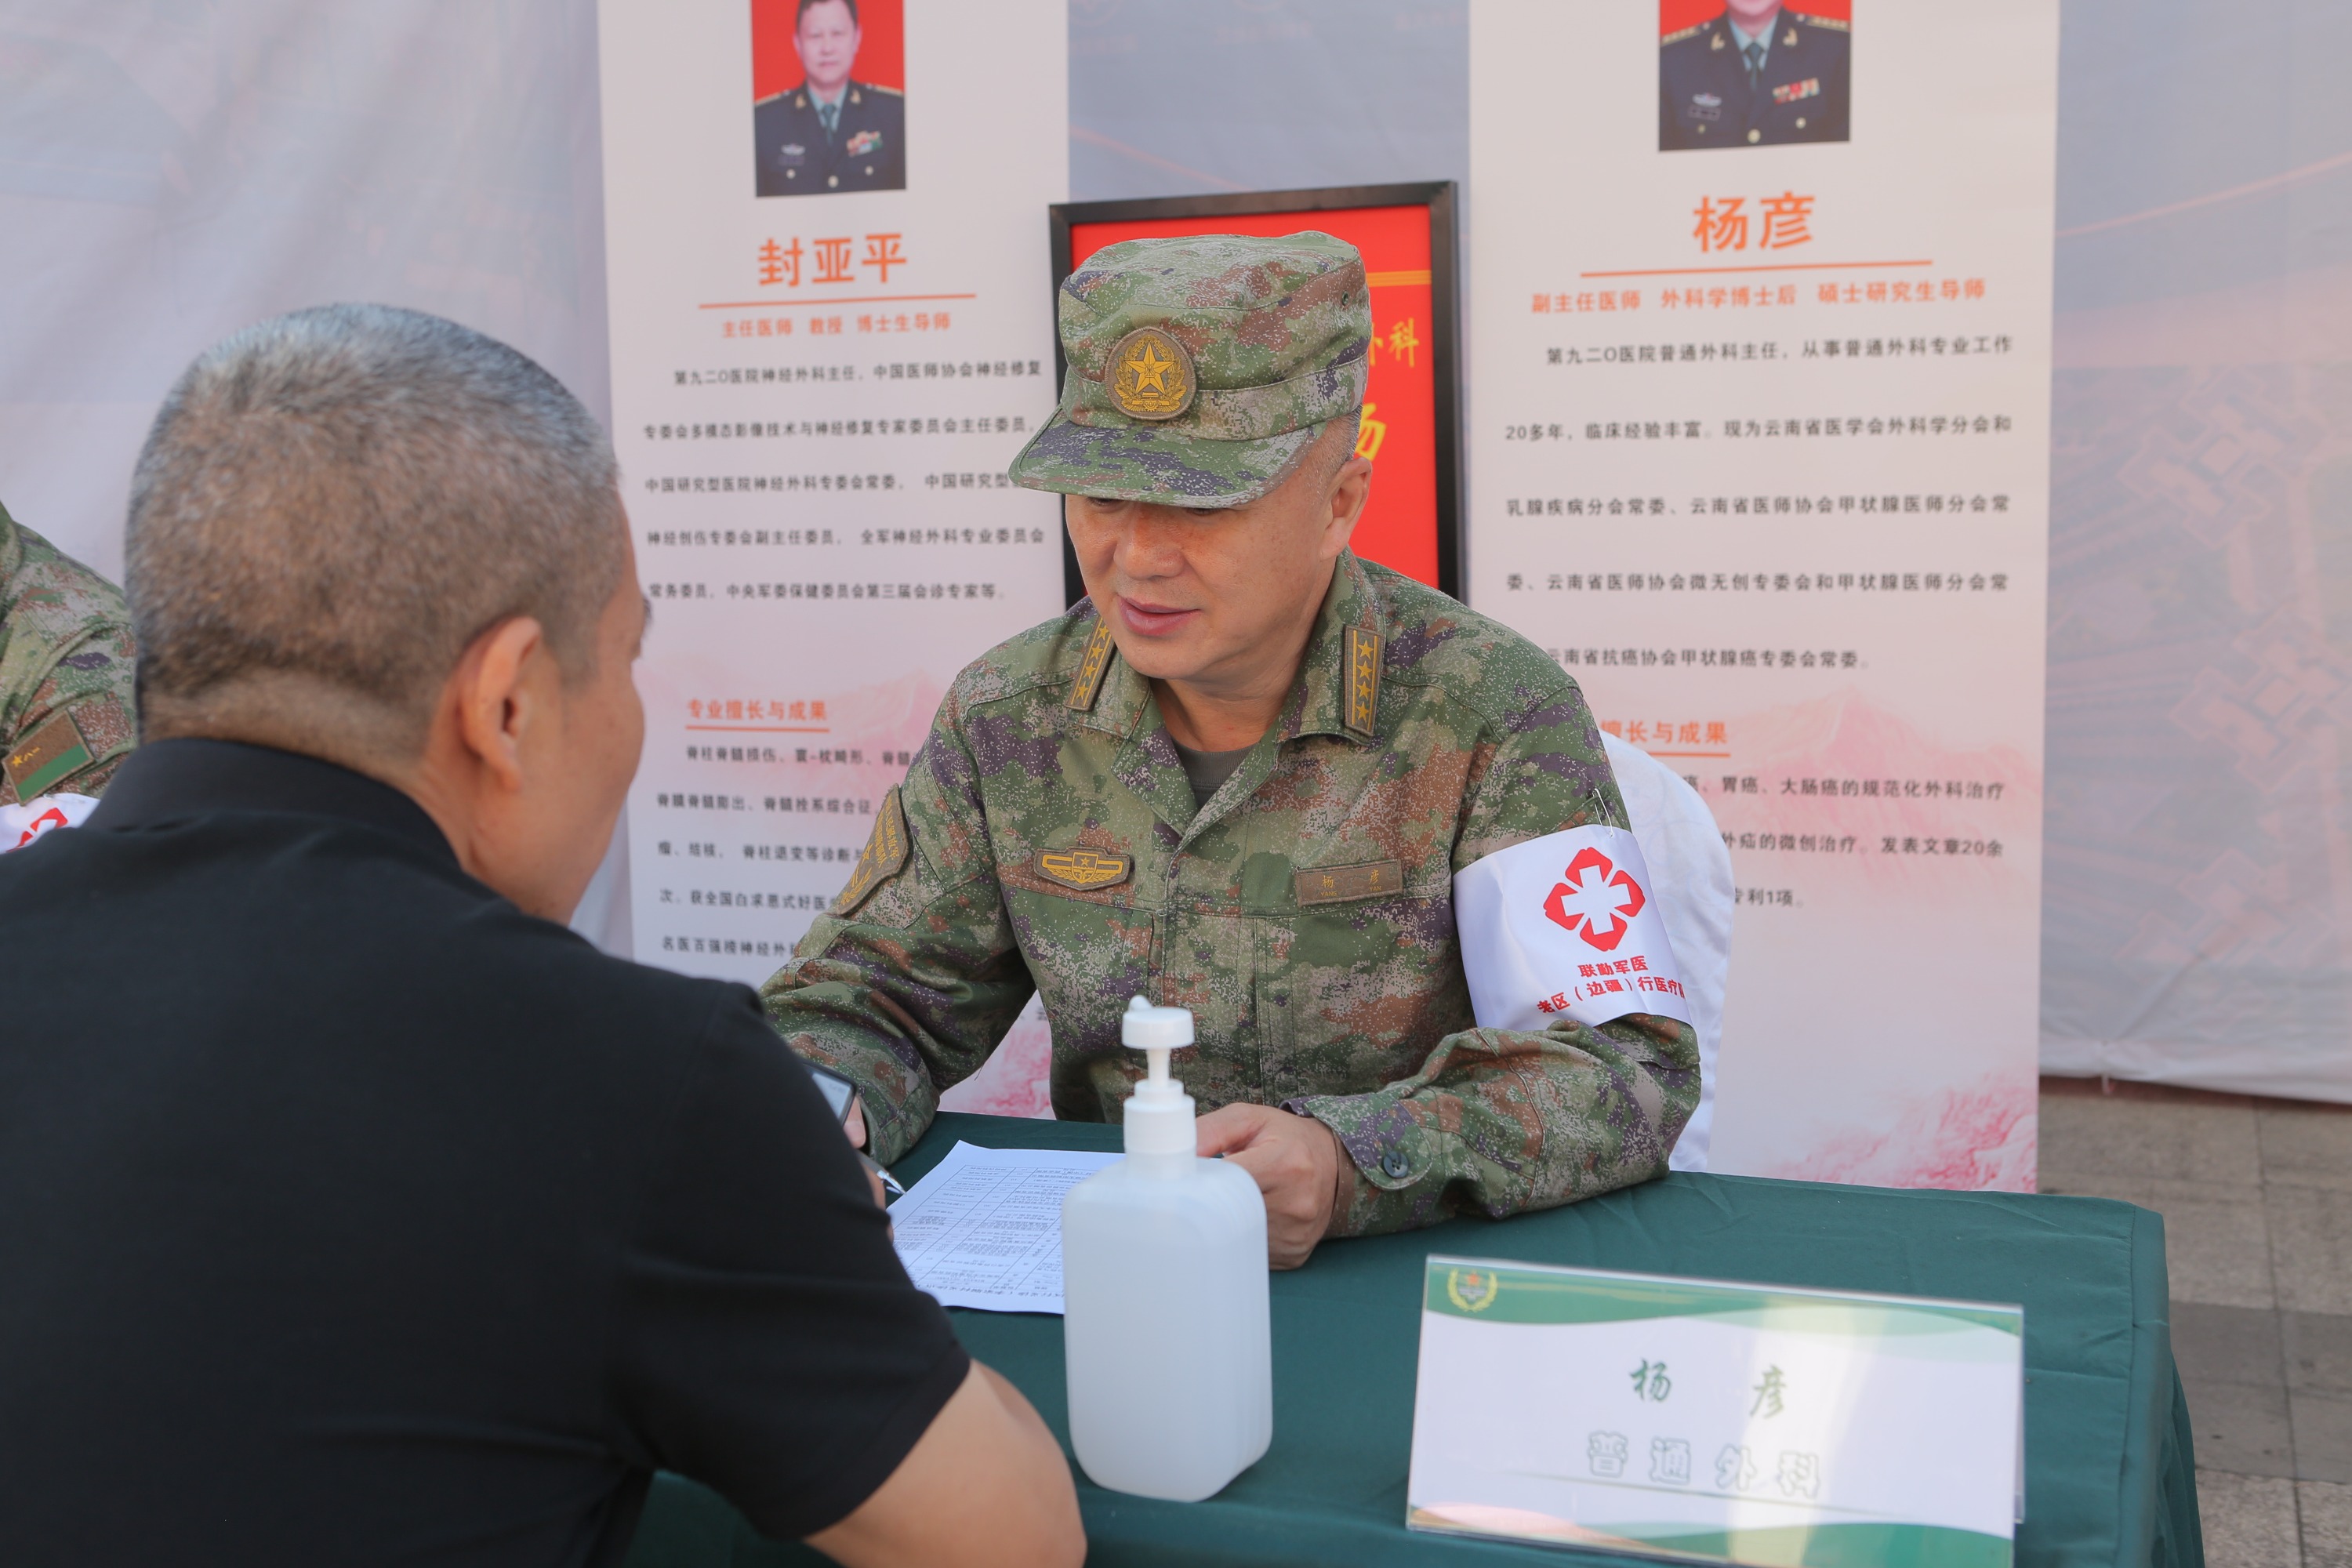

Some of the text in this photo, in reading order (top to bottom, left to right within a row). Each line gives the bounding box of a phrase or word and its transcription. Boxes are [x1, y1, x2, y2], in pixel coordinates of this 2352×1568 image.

[1692, 191, 1816, 253] 杨彦
[758, 232, 907, 288] 封亚平
[1531, 278, 1986, 314] 副主任医师 外科学博士后 硕士研究生导师
[724, 312, 950, 338] 主任医师 教授 博士生导师
[924, 472, 1019, 492] 中国研究型
[688, 699, 827, 721] 专业擅长与成果
[1577, 955, 1649, 978] 联勤军医
[1629, 1359, 1785, 1416] 杨 彦
[1588, 1430, 1820, 1499] 普通外科
